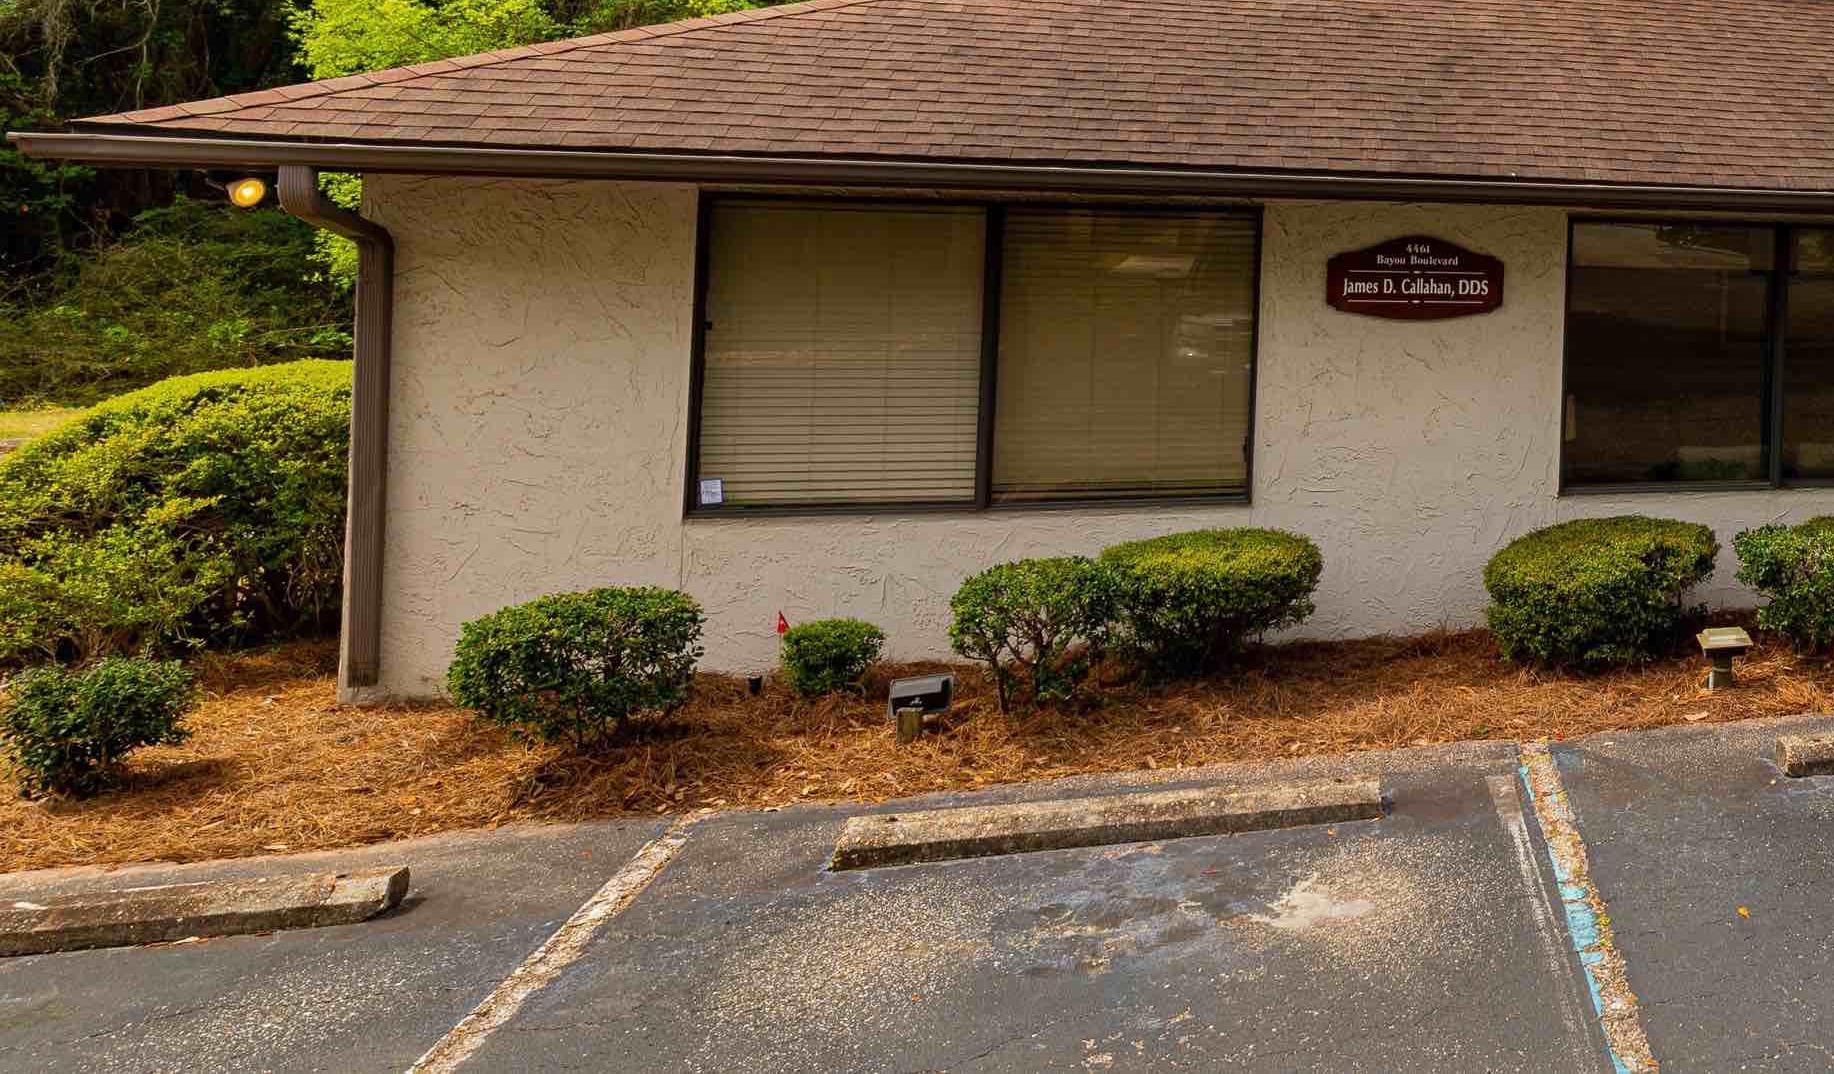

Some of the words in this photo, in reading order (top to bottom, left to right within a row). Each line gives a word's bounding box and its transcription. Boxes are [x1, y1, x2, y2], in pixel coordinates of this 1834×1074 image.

[1376, 254, 1406, 267] Bayou
[1410, 254, 1459, 266] Boulevard
[1343, 278, 1379, 296] James
[1383, 278, 1397, 295] D.
[1401, 278, 1455, 297] Callahan,
[1458, 279, 1489, 296] DDS
